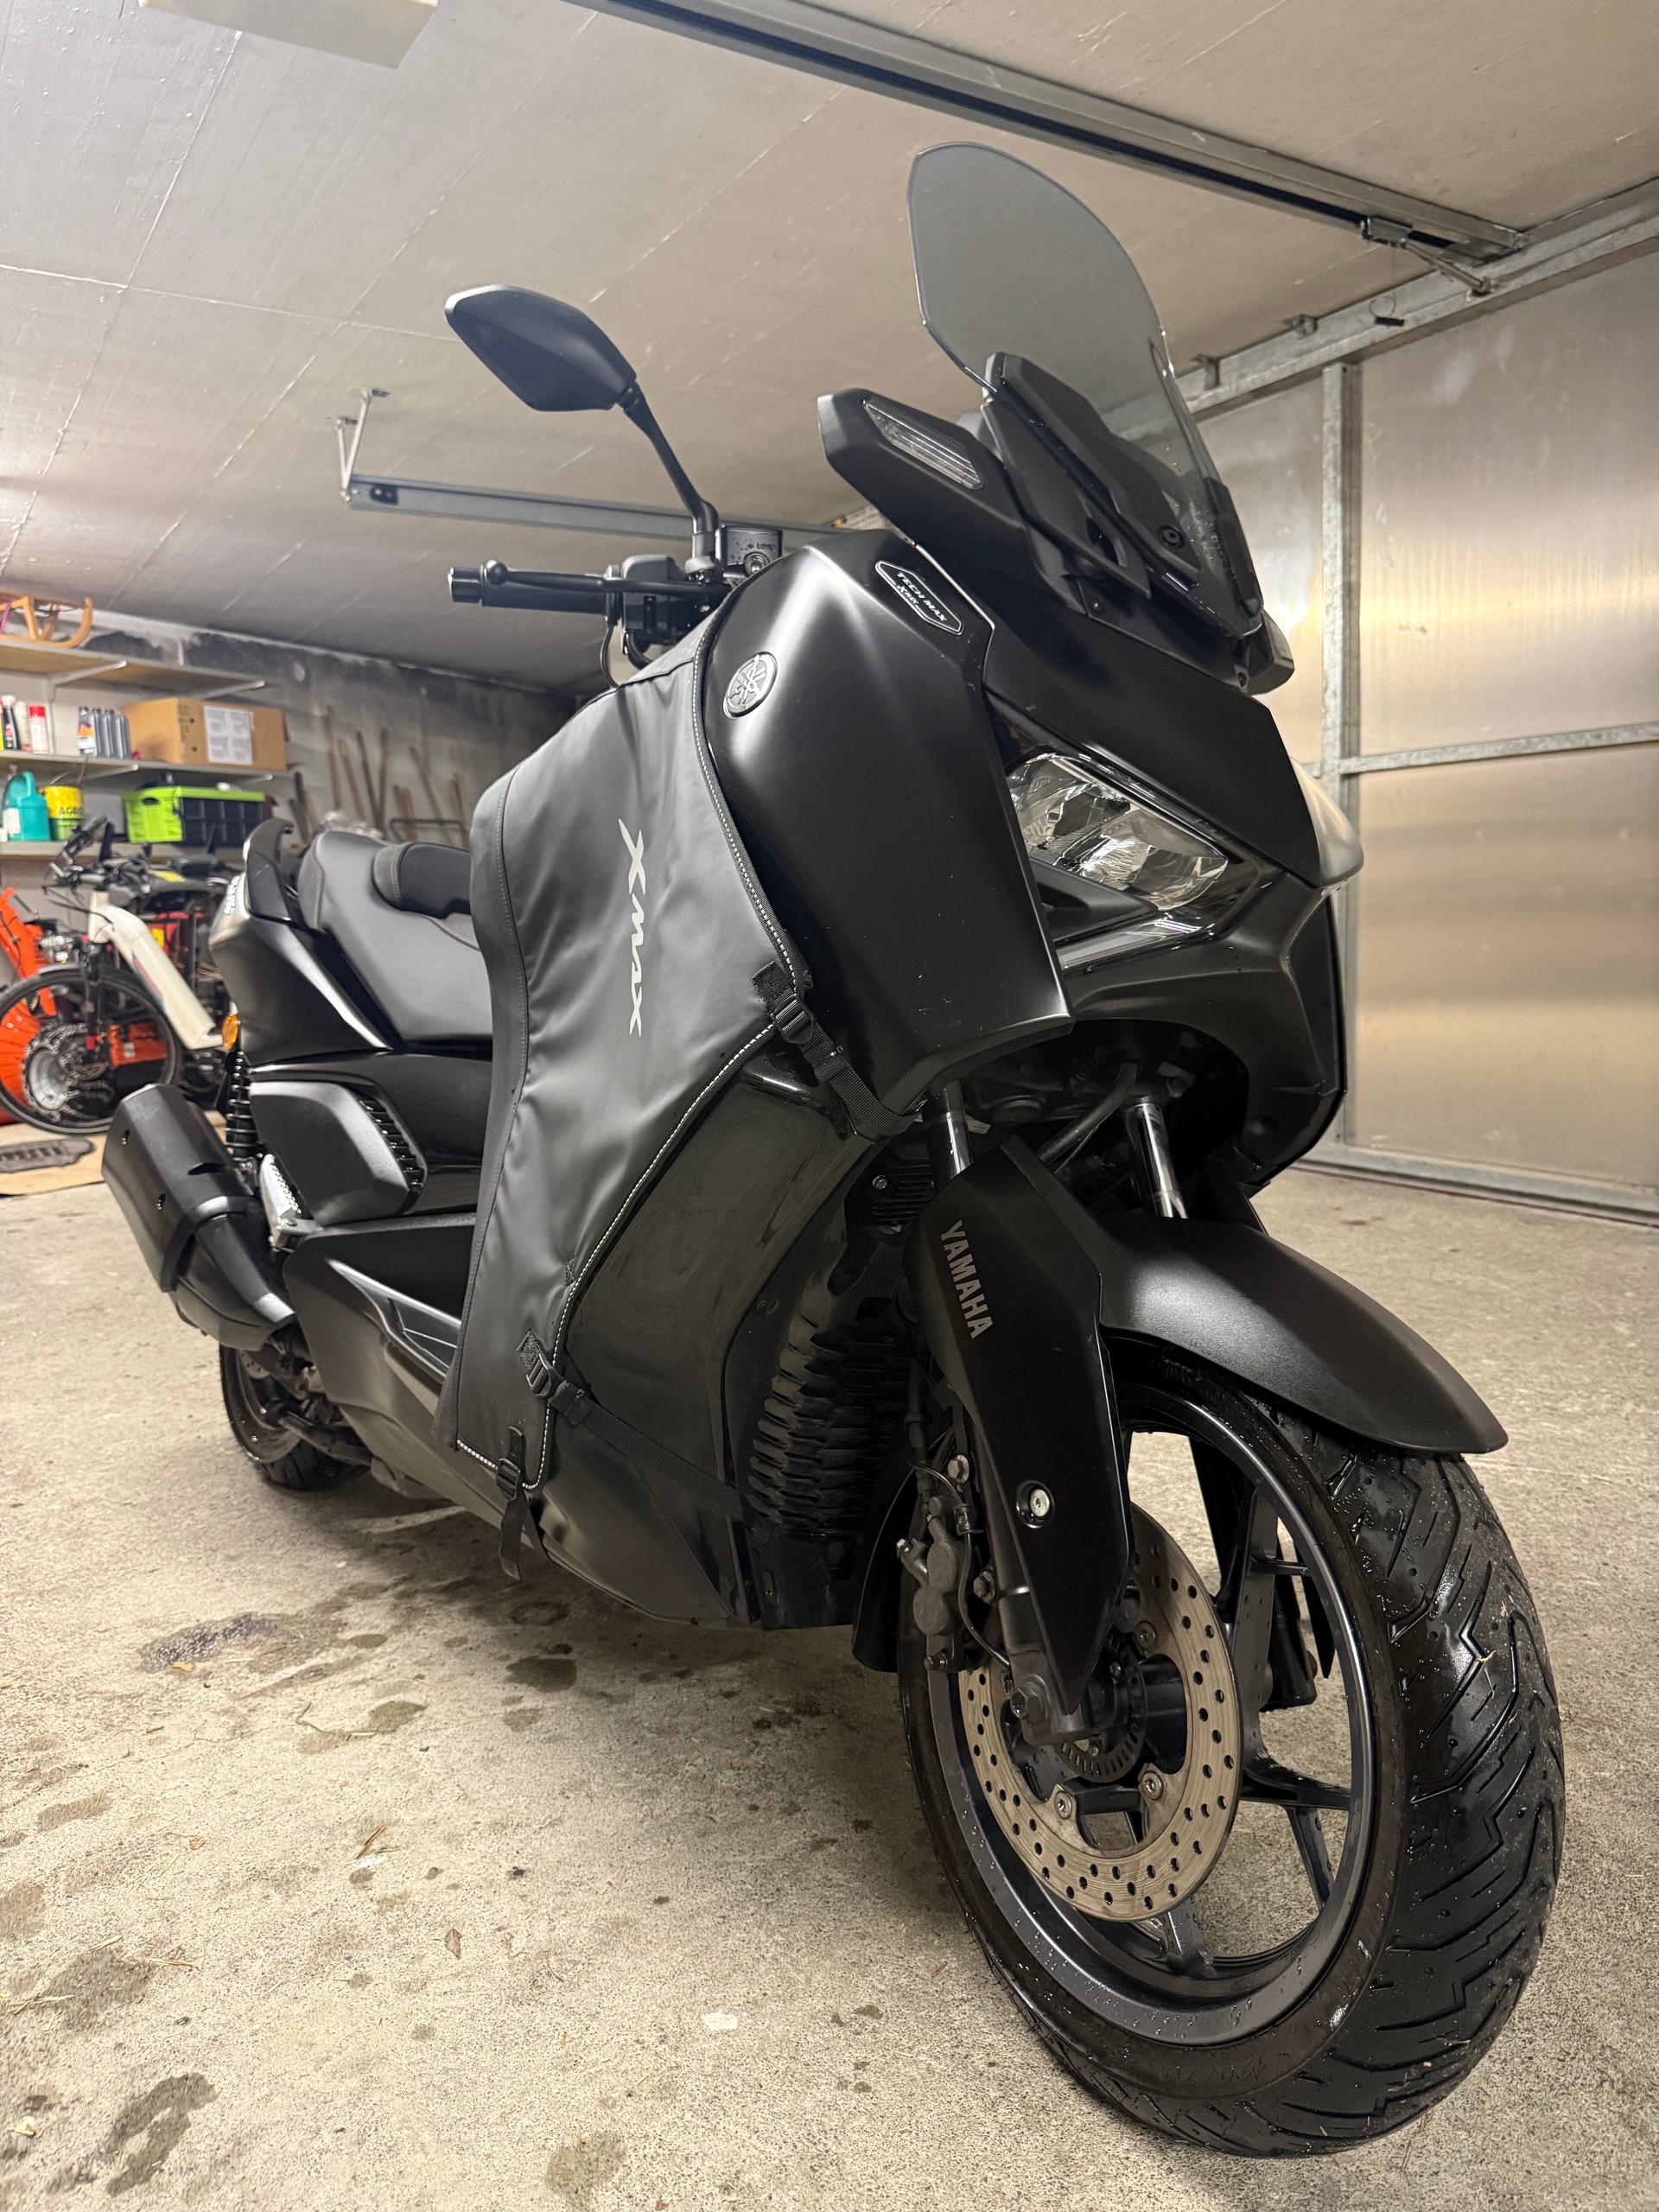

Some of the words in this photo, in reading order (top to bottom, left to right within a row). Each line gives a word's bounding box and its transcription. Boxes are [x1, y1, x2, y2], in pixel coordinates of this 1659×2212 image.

[897, 572, 925, 599] TECH
[923, 600, 947, 621] MAX
[940, 1219, 994, 1339] YAMAHA
